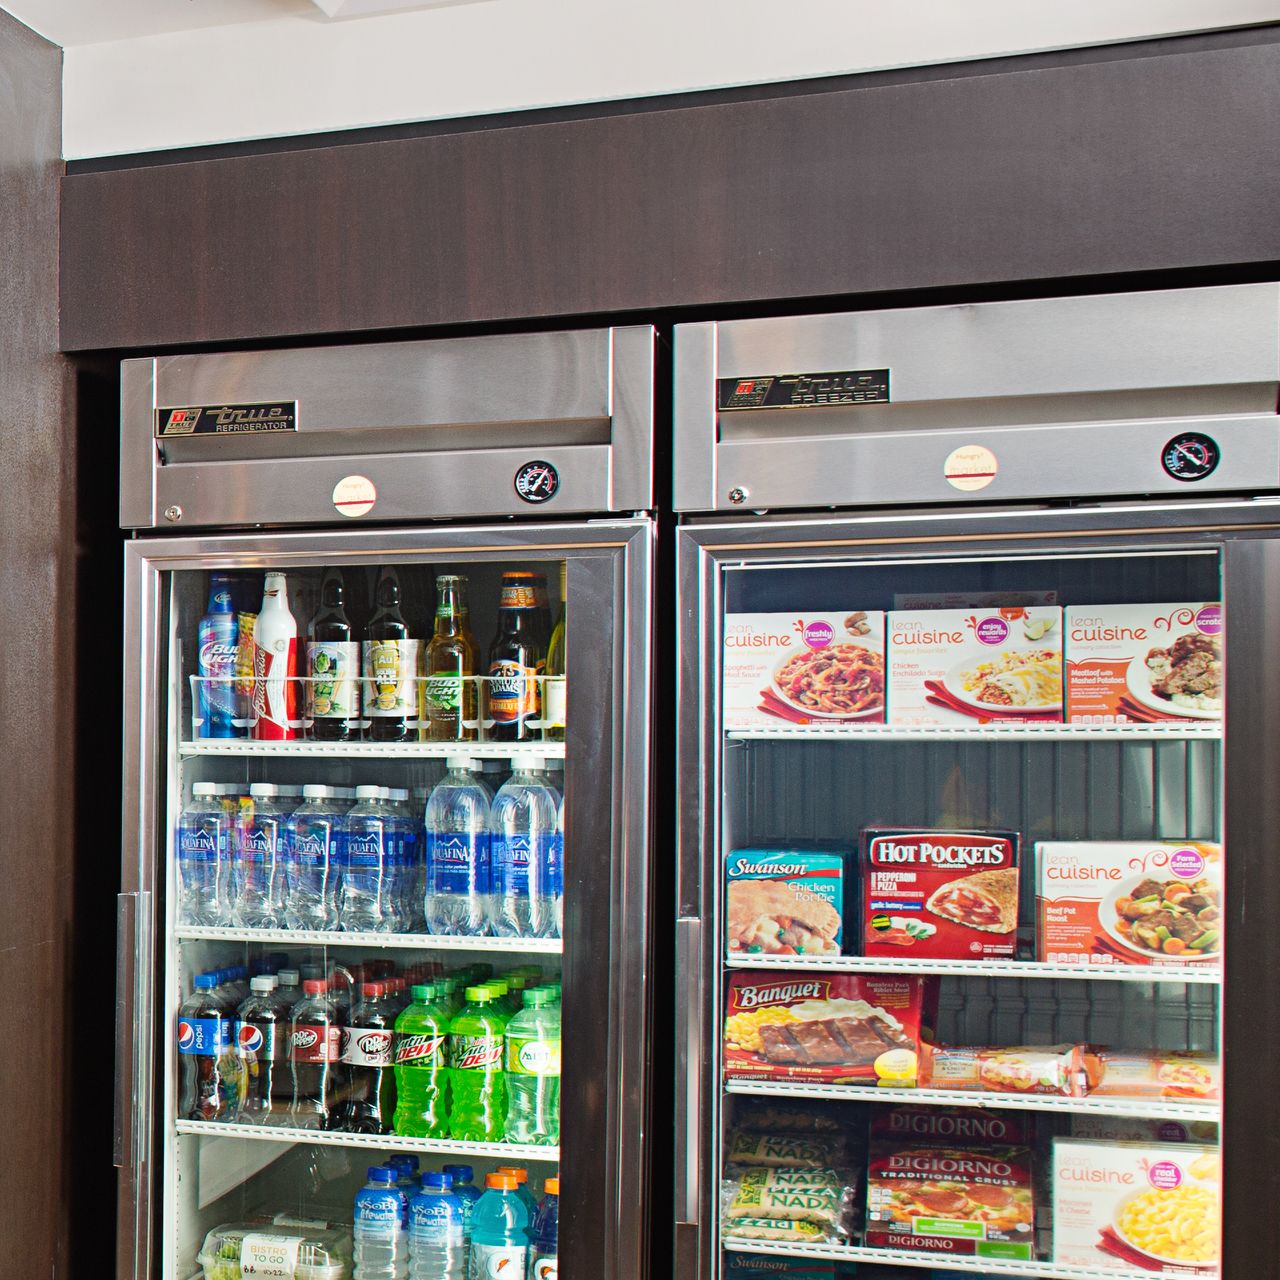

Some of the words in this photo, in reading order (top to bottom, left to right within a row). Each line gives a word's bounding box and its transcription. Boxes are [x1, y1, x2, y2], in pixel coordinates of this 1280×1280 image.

[789, 390, 879, 405] FREEZER
[215, 421, 287, 432] REFRIGERATOR
[892, 620, 923, 631] lean
[1070, 616, 1105, 627] lean
[804, 628, 833, 640] freshly
[982, 624, 1003, 632] enjoy
[1071, 626, 1148, 642] cuisine
[725, 632, 792, 648] cuisine
[892, 629, 965, 645] cuisine
[378, 655, 393, 664] Au
[428, 678, 460, 688] BUD
[878, 842, 919, 862] HOT
[919, 842, 1005, 865] POCKETS
[1046, 853, 1079, 865] lean
[1176, 854, 1196, 862] Farm
[728, 858, 808, 878] Swanson
[1170, 861, 1202, 869] Selected
[877, 872, 917, 882] PEPPERONI
[1046, 864, 1123, 880] cuisine
[787, 881, 835, 893] Chicken
[877, 882, 898, 892] PIZZA
[794, 891, 814, 902] Pot
[816, 893, 835, 903] Pie
[1046, 906, 1062, 915] Beef
[1063, 907, 1076, 915] Pot
[1046, 914, 1069, 923] Roast
[740, 981, 822, 1007] Banquet
[195, 1024, 203, 1049] pepsi
[397, 1040, 438, 1060] DEW
[880, 1171, 970, 1182] TRADITIONAL
[974, 1176, 1019, 1187] CRUST
[1059, 1166, 1135, 1185] cuisine
[1155, 1169, 1176, 1178] real
[773, 1174, 835, 1187] NADA
[768, 1186, 838, 1199] PIZZA
[770, 1195, 837, 1211] NADA
[250, 1244, 288, 1256] BISTRO
[254, 1254, 267, 1263] TO
[268, 1255, 284, 1264] GO
